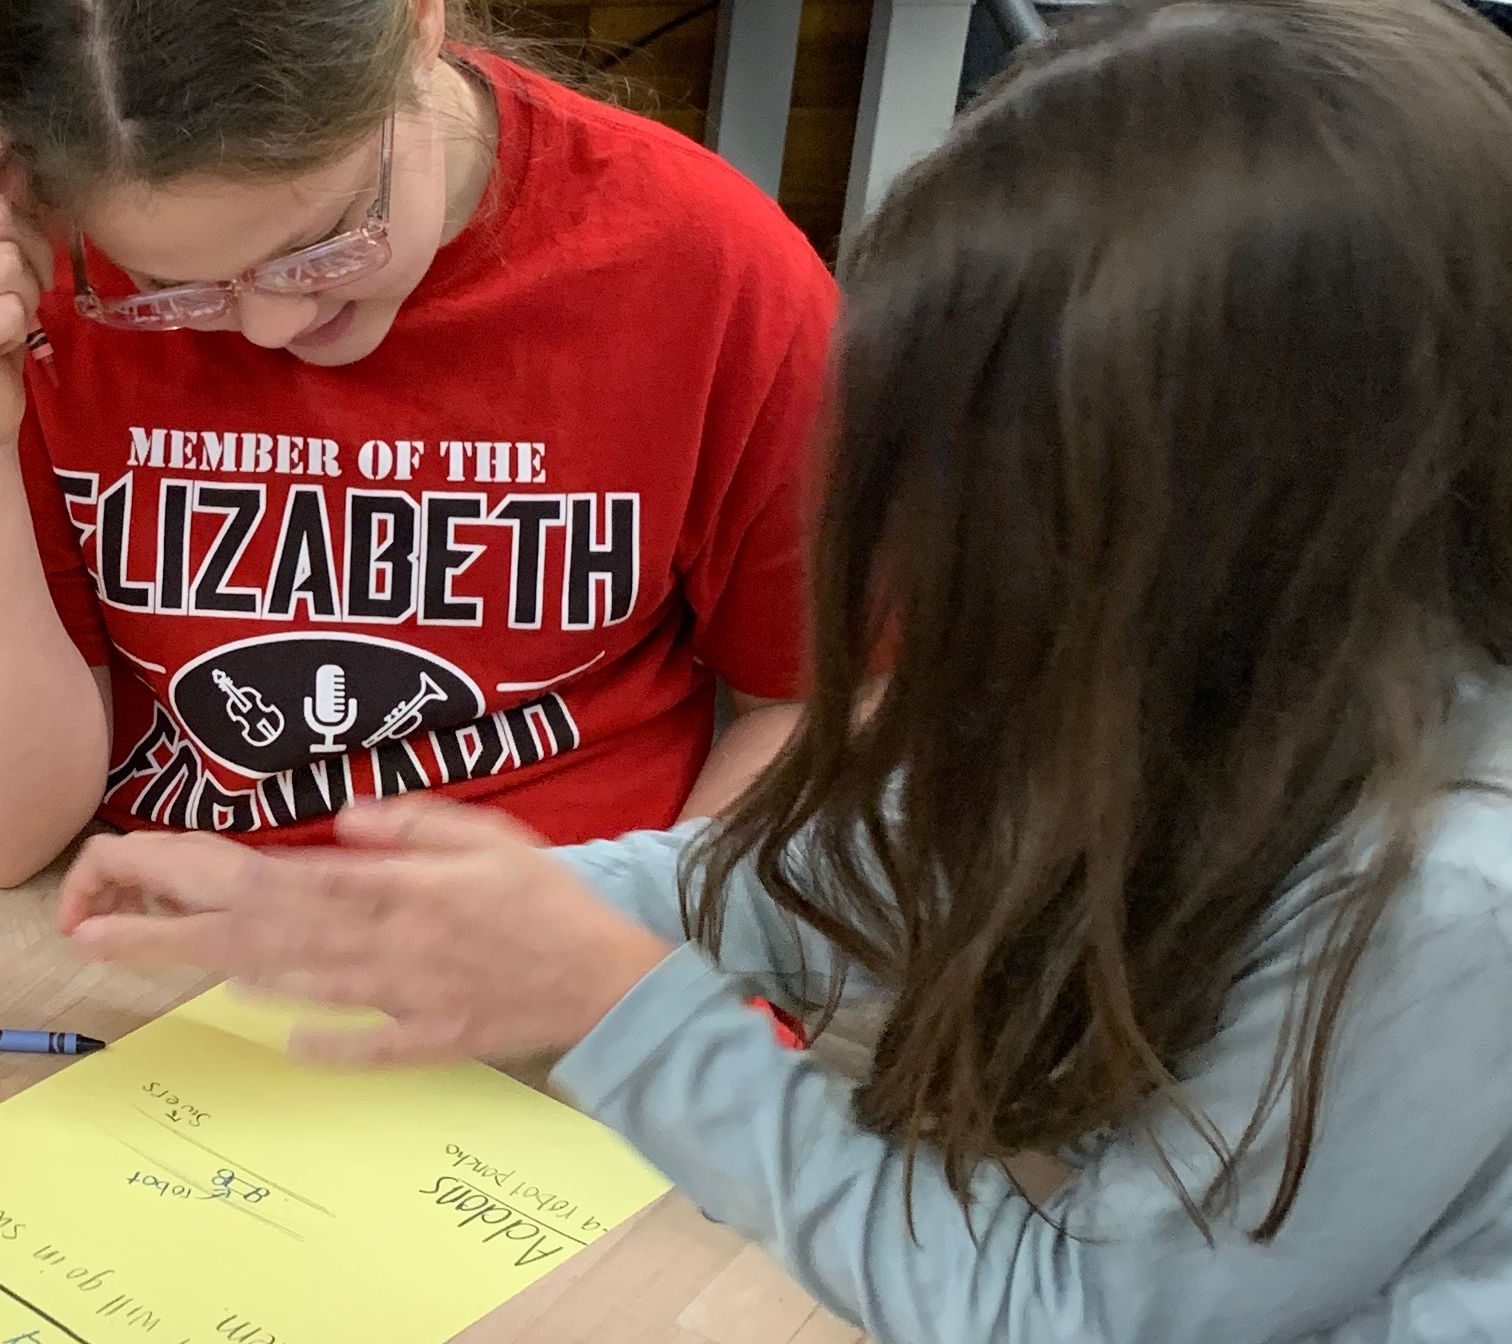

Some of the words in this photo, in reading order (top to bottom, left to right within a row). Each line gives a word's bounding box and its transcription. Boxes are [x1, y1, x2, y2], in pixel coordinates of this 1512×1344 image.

[127, 427, 342, 478] MEMBER
[358, 439, 424, 482] OF
[440, 440, 546, 484] THE
[445, 1143, 516, 1188] poncho
[127, 1171, 192, 1199] robot
[509, 1181, 578, 1220] robot
[419, 1176, 563, 1267] Addons
[32, 1244, 66, 1275] in
[65, 1269, 115, 1292] go
[95, 1294, 161, 1332] will
